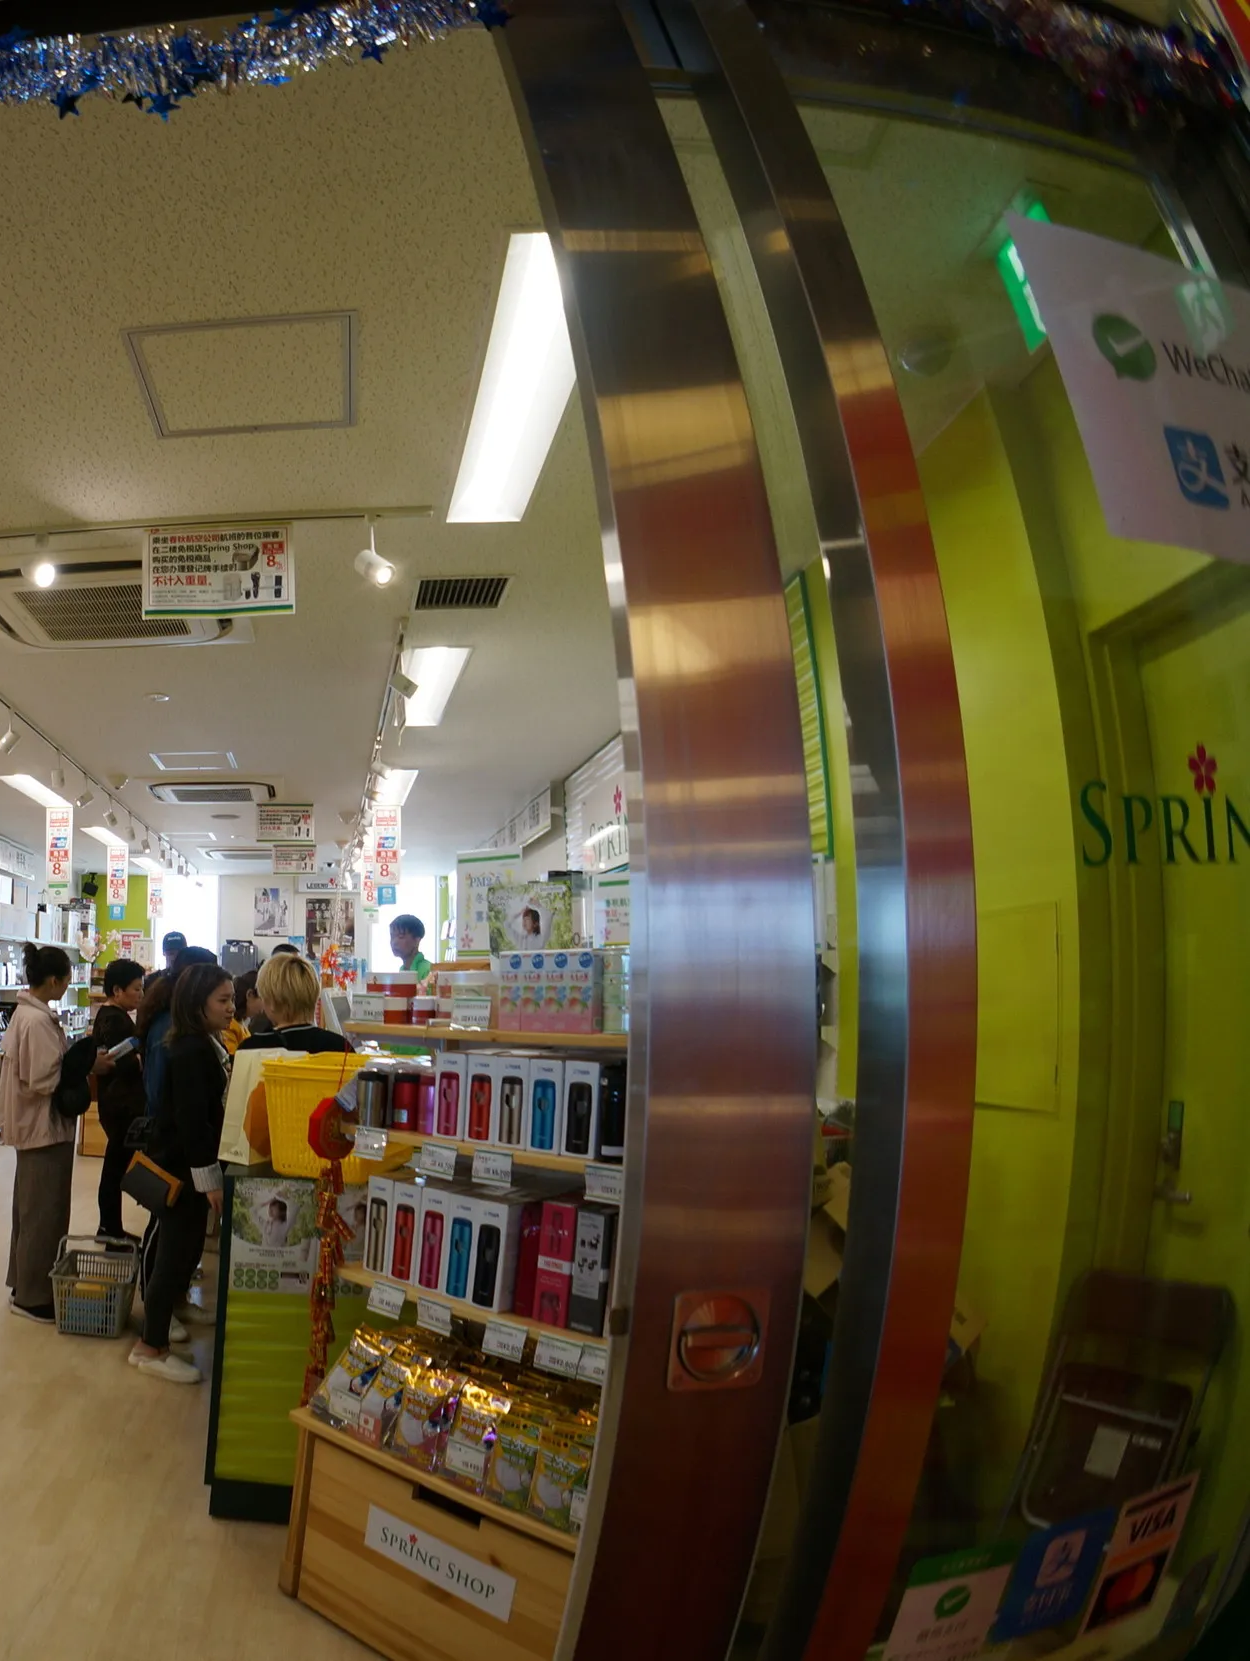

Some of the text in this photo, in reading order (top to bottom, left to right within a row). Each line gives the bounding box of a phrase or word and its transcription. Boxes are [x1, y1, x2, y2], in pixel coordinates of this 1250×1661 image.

[233, 541, 254, 551] Shop
[1128, 1503, 1178, 1544] VISA
[379, 1526, 496, 1599] SPRING SHOP
